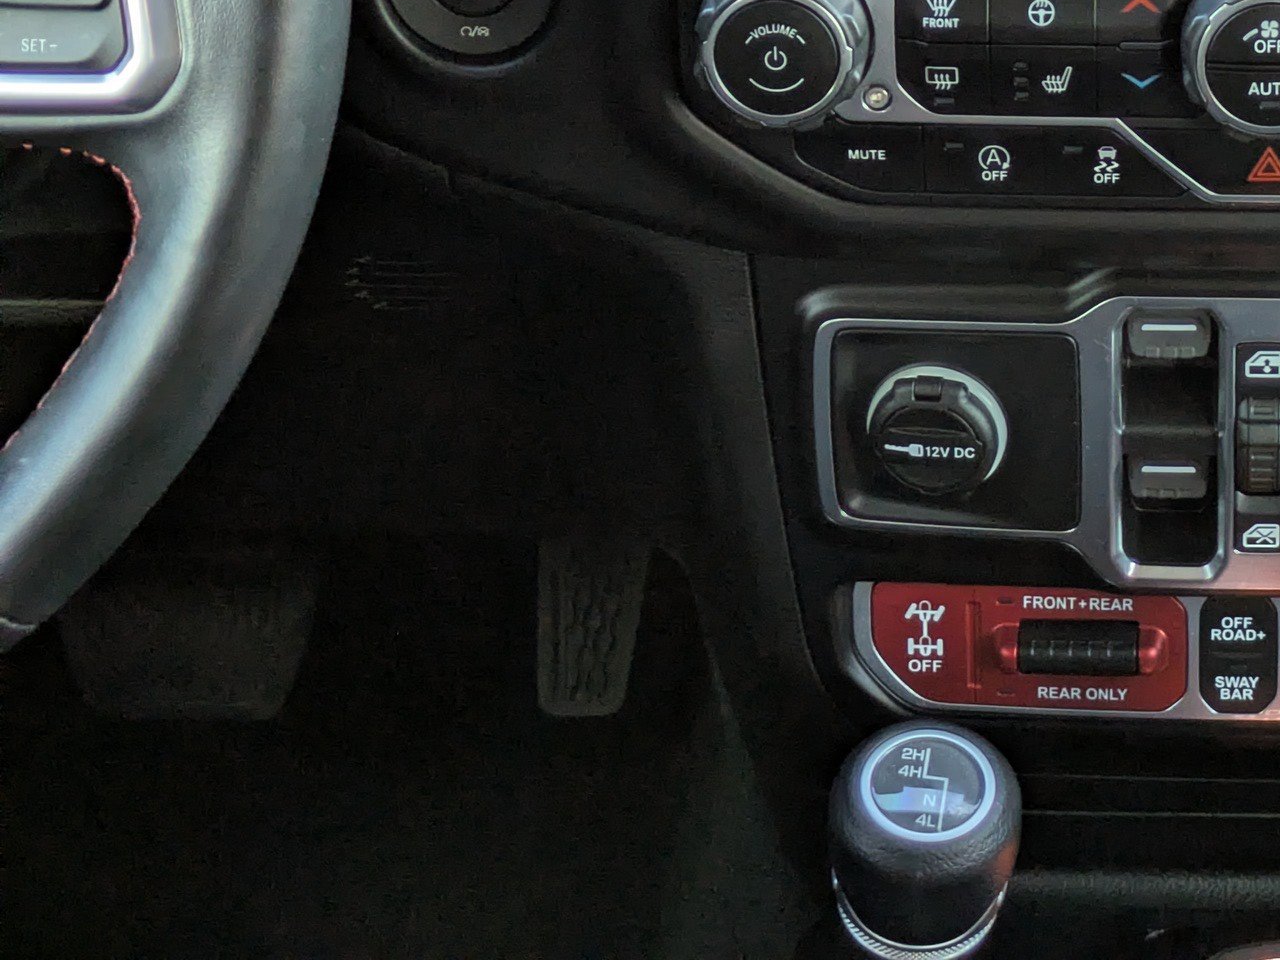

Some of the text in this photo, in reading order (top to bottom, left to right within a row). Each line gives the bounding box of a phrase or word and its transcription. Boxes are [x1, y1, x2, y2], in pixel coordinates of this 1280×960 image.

[922, 17, 960, 29] FRONT
[750, 23, 798, 40] VOLUME
[848, 149, 886, 161] MUTE
[981, 170, 1008, 182] OFF
[1093, 172, 1120, 184] OFF
[925, 446, 976, 459] 12V DC
[1220, 616, 1254, 629] OFF
[1210, 628, 1266, 643] ROAD+
[907, 659, 943, 674] OFF
[1214, 675, 1260, 690] SWAY
[1037, 686, 1128, 702] REAR ONLY
[1220, 688, 1254, 701] BAR
[901, 747, 925, 762] 2H
[898, 765, 923, 779] 4H
[923, 793, 936, 807] N
[915, 813, 936, 828] 4L
